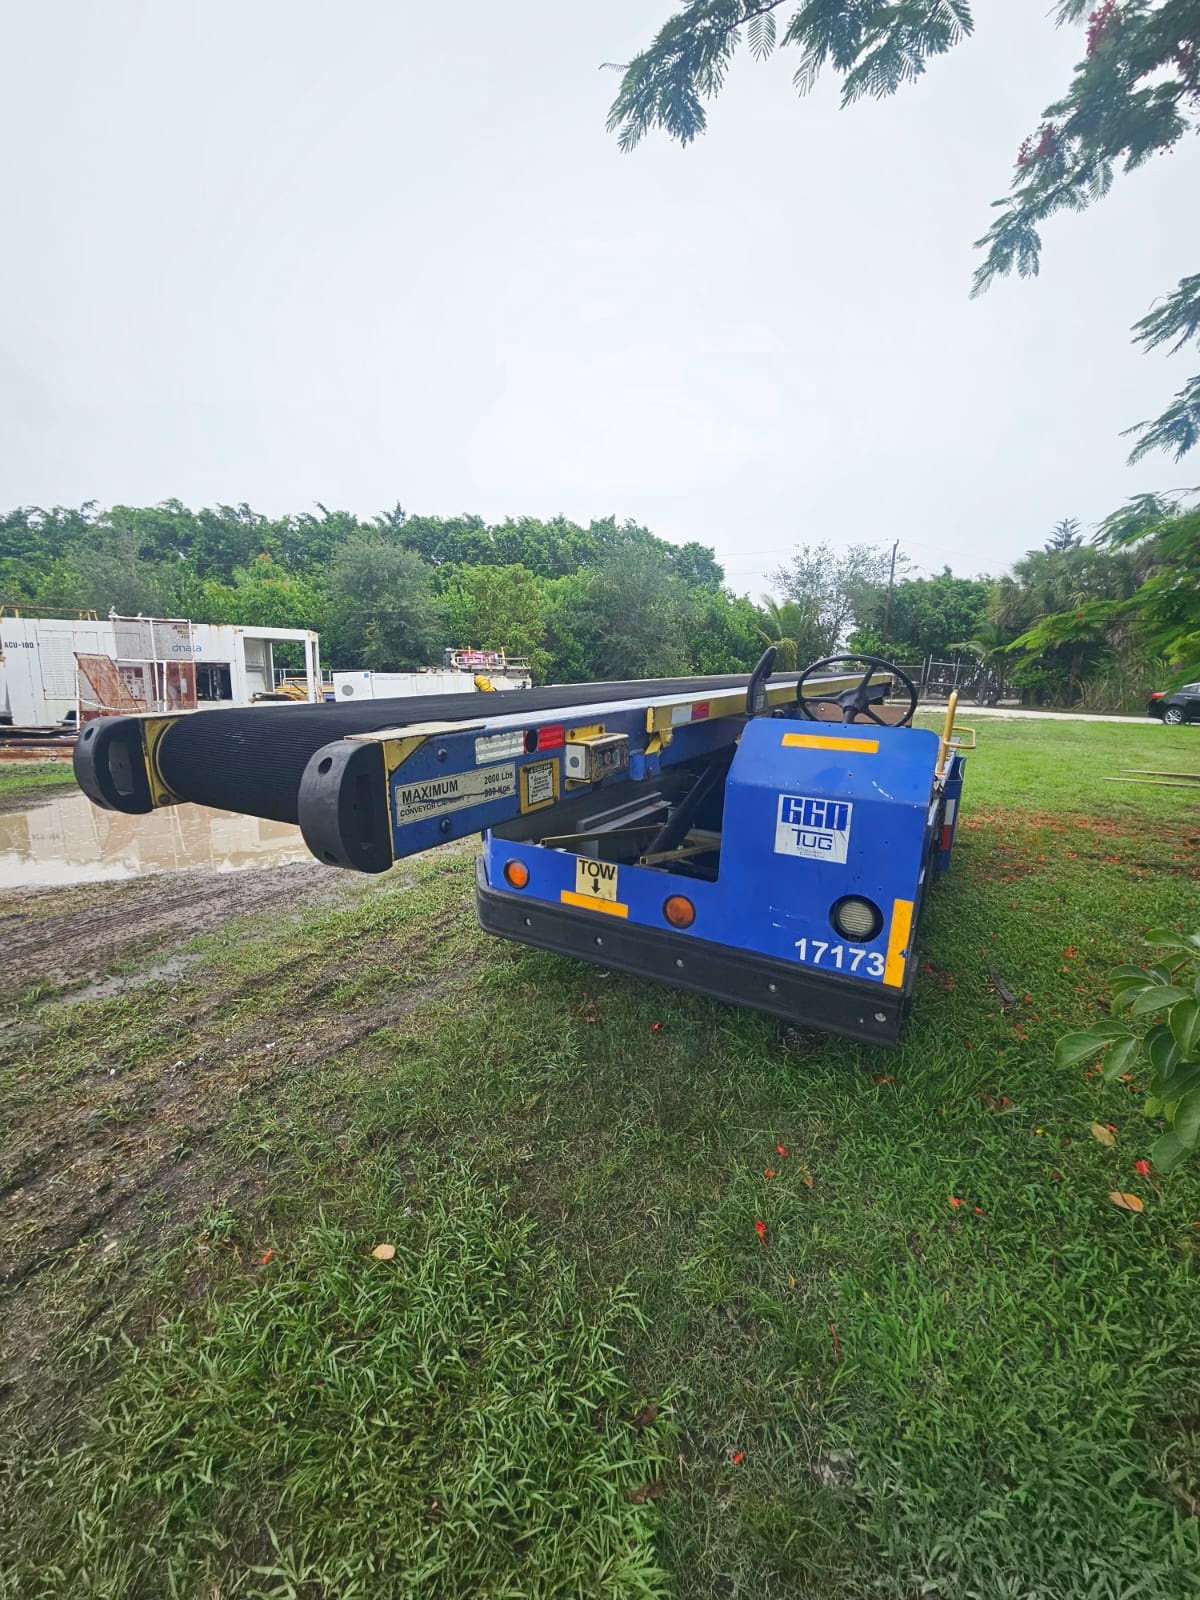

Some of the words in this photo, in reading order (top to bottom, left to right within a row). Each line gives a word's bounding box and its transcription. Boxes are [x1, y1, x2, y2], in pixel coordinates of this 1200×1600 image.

[484, 773, 500, 785] 2000
[501, 770, 513, 781] Lbs
[402, 780, 459, 804] MAXIMUM
[400, 800, 436, 817] CONVEYOR
[781, 796, 849, 832] 660
[791, 828, 834, 851] TUG
[578, 859, 616, 881] TOW
[794, 938, 885, 977] 17173
